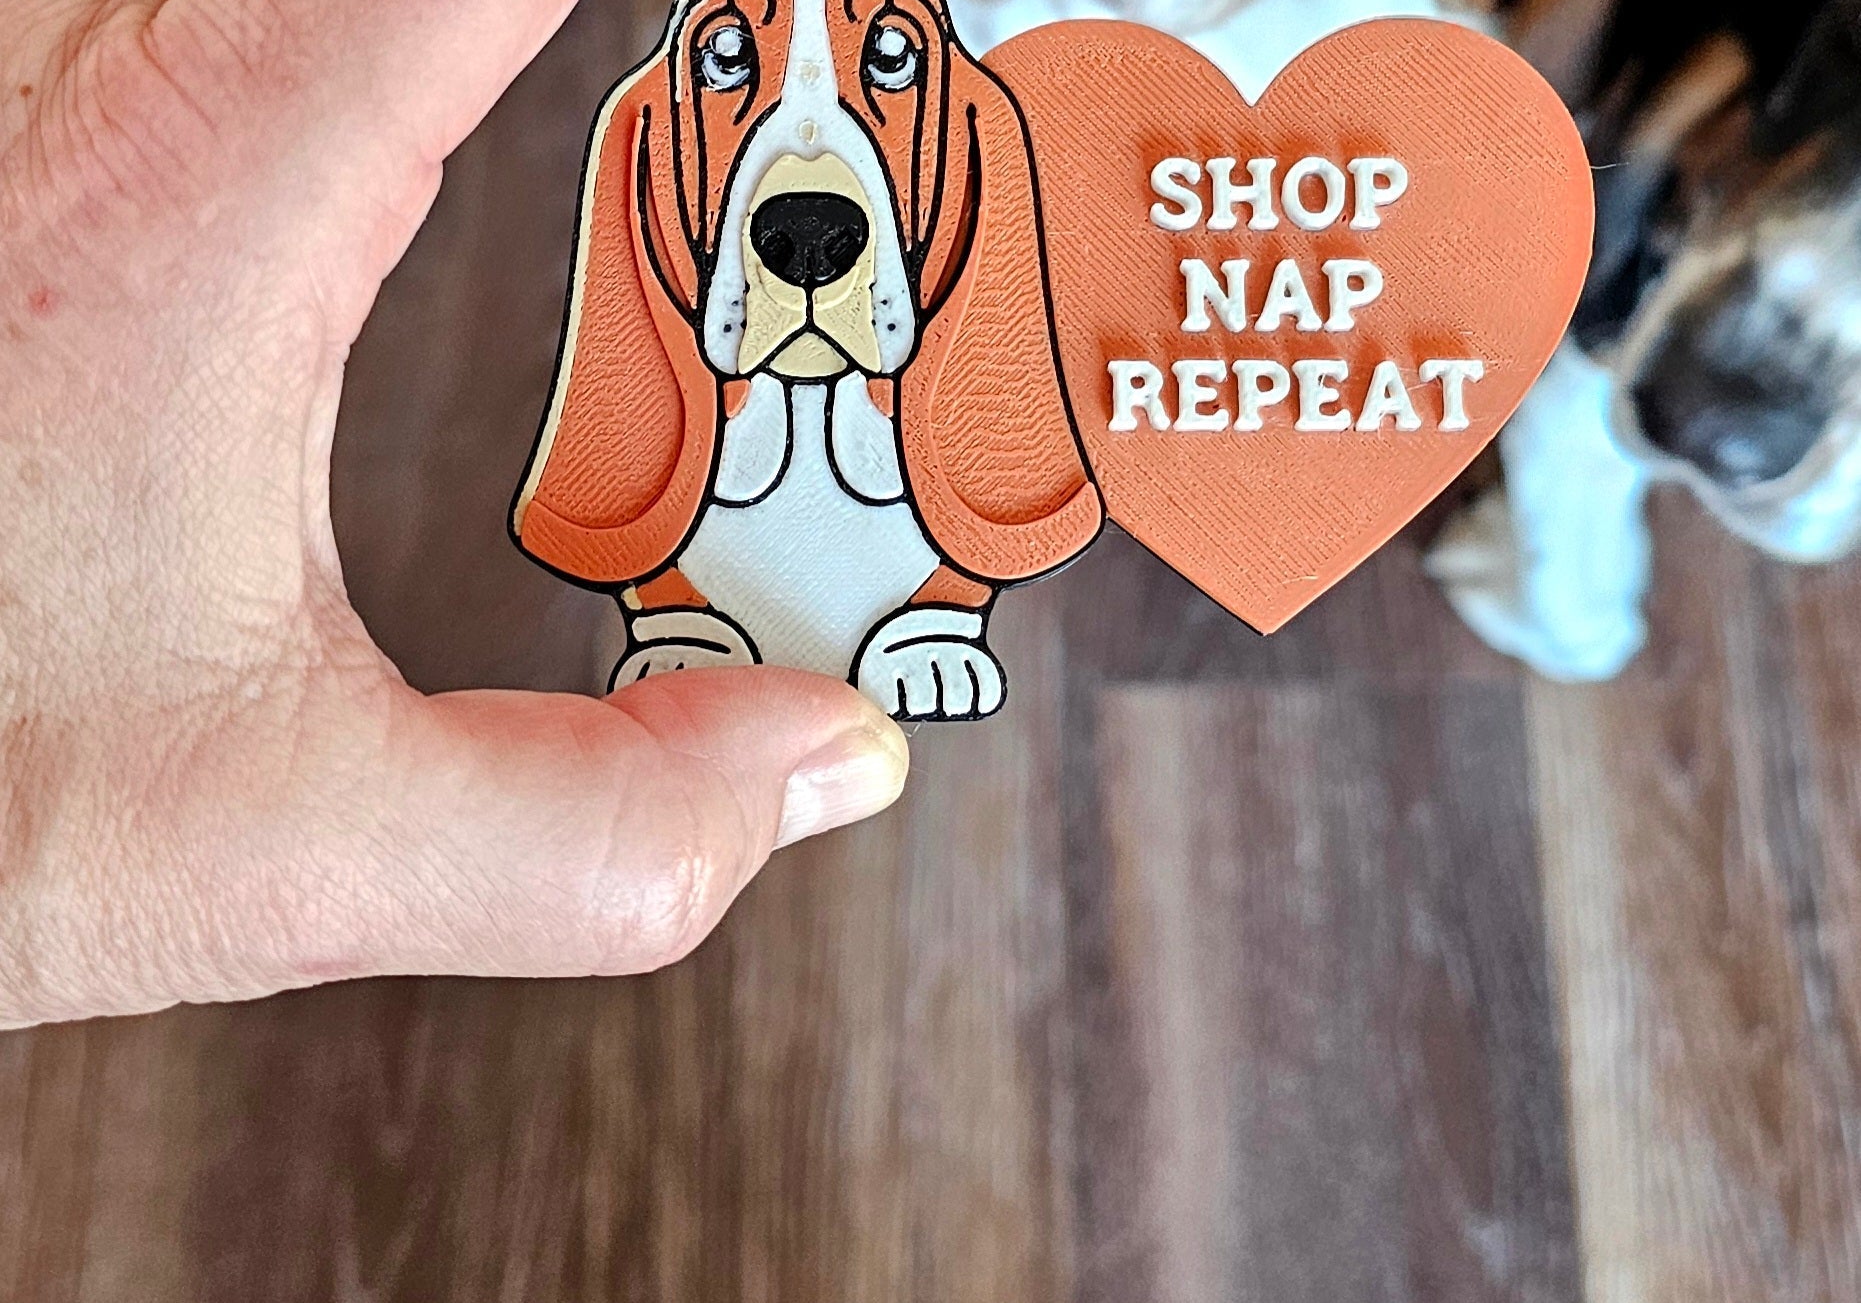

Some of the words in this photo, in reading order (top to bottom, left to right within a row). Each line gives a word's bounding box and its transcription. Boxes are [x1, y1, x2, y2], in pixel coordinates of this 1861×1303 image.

[1149, 156, 1409, 231] SHOP
[1179, 258, 1385, 333] NAP
[1107, 358, 1485, 433] REPEAT
